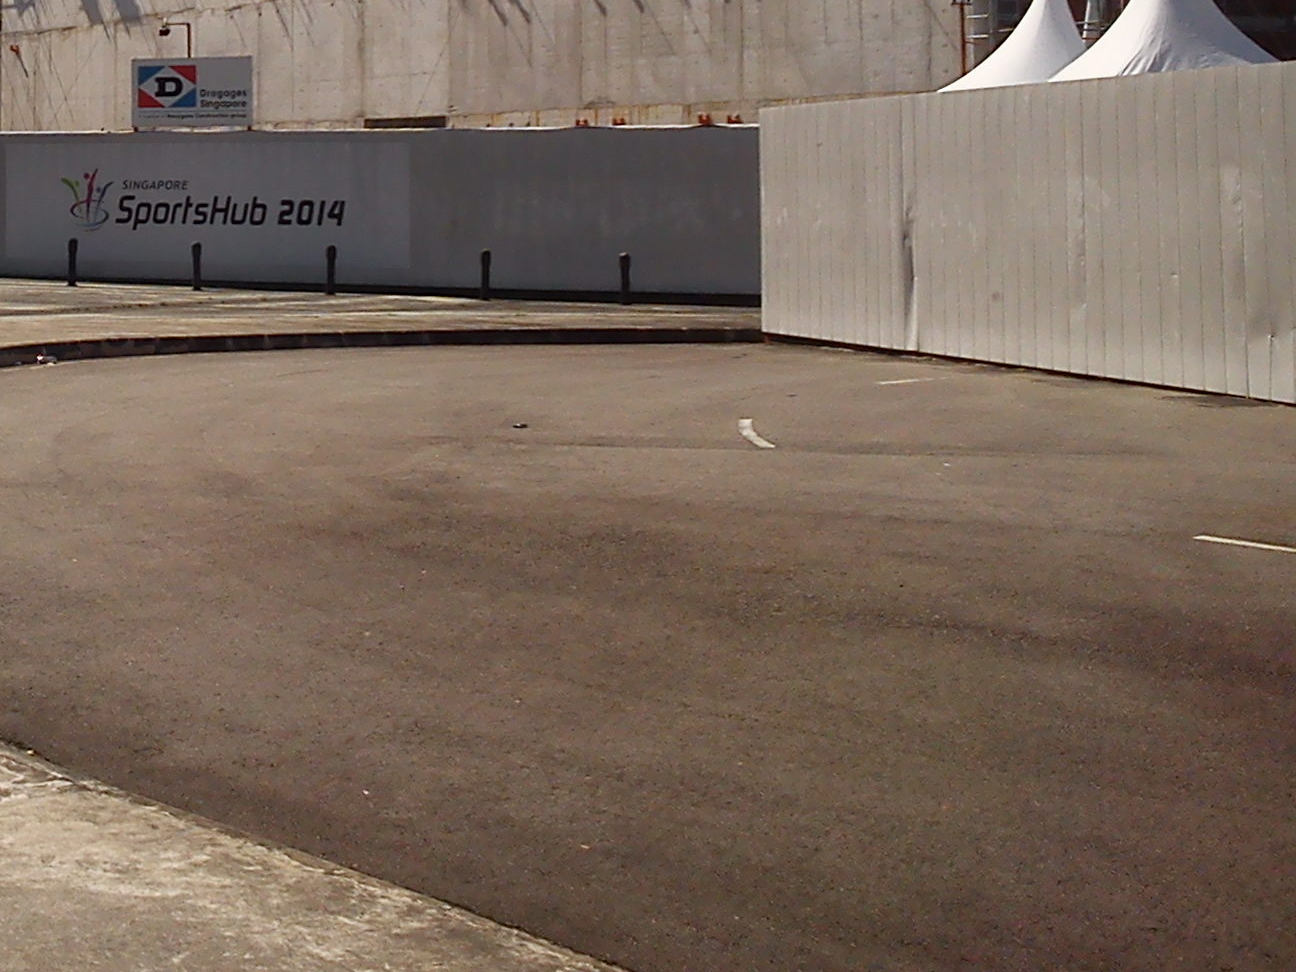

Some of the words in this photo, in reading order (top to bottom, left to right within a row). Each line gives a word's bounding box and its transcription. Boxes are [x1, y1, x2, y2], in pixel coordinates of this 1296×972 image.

[155, 77, 183, 97] D
[199, 89, 247, 99] Dragages
[200, 99, 247, 109] Singapore
[122, 180, 190, 190] SINGAPORE
[115, 195, 268, 231] SportsHub
[277, 199, 347, 226] 2014
